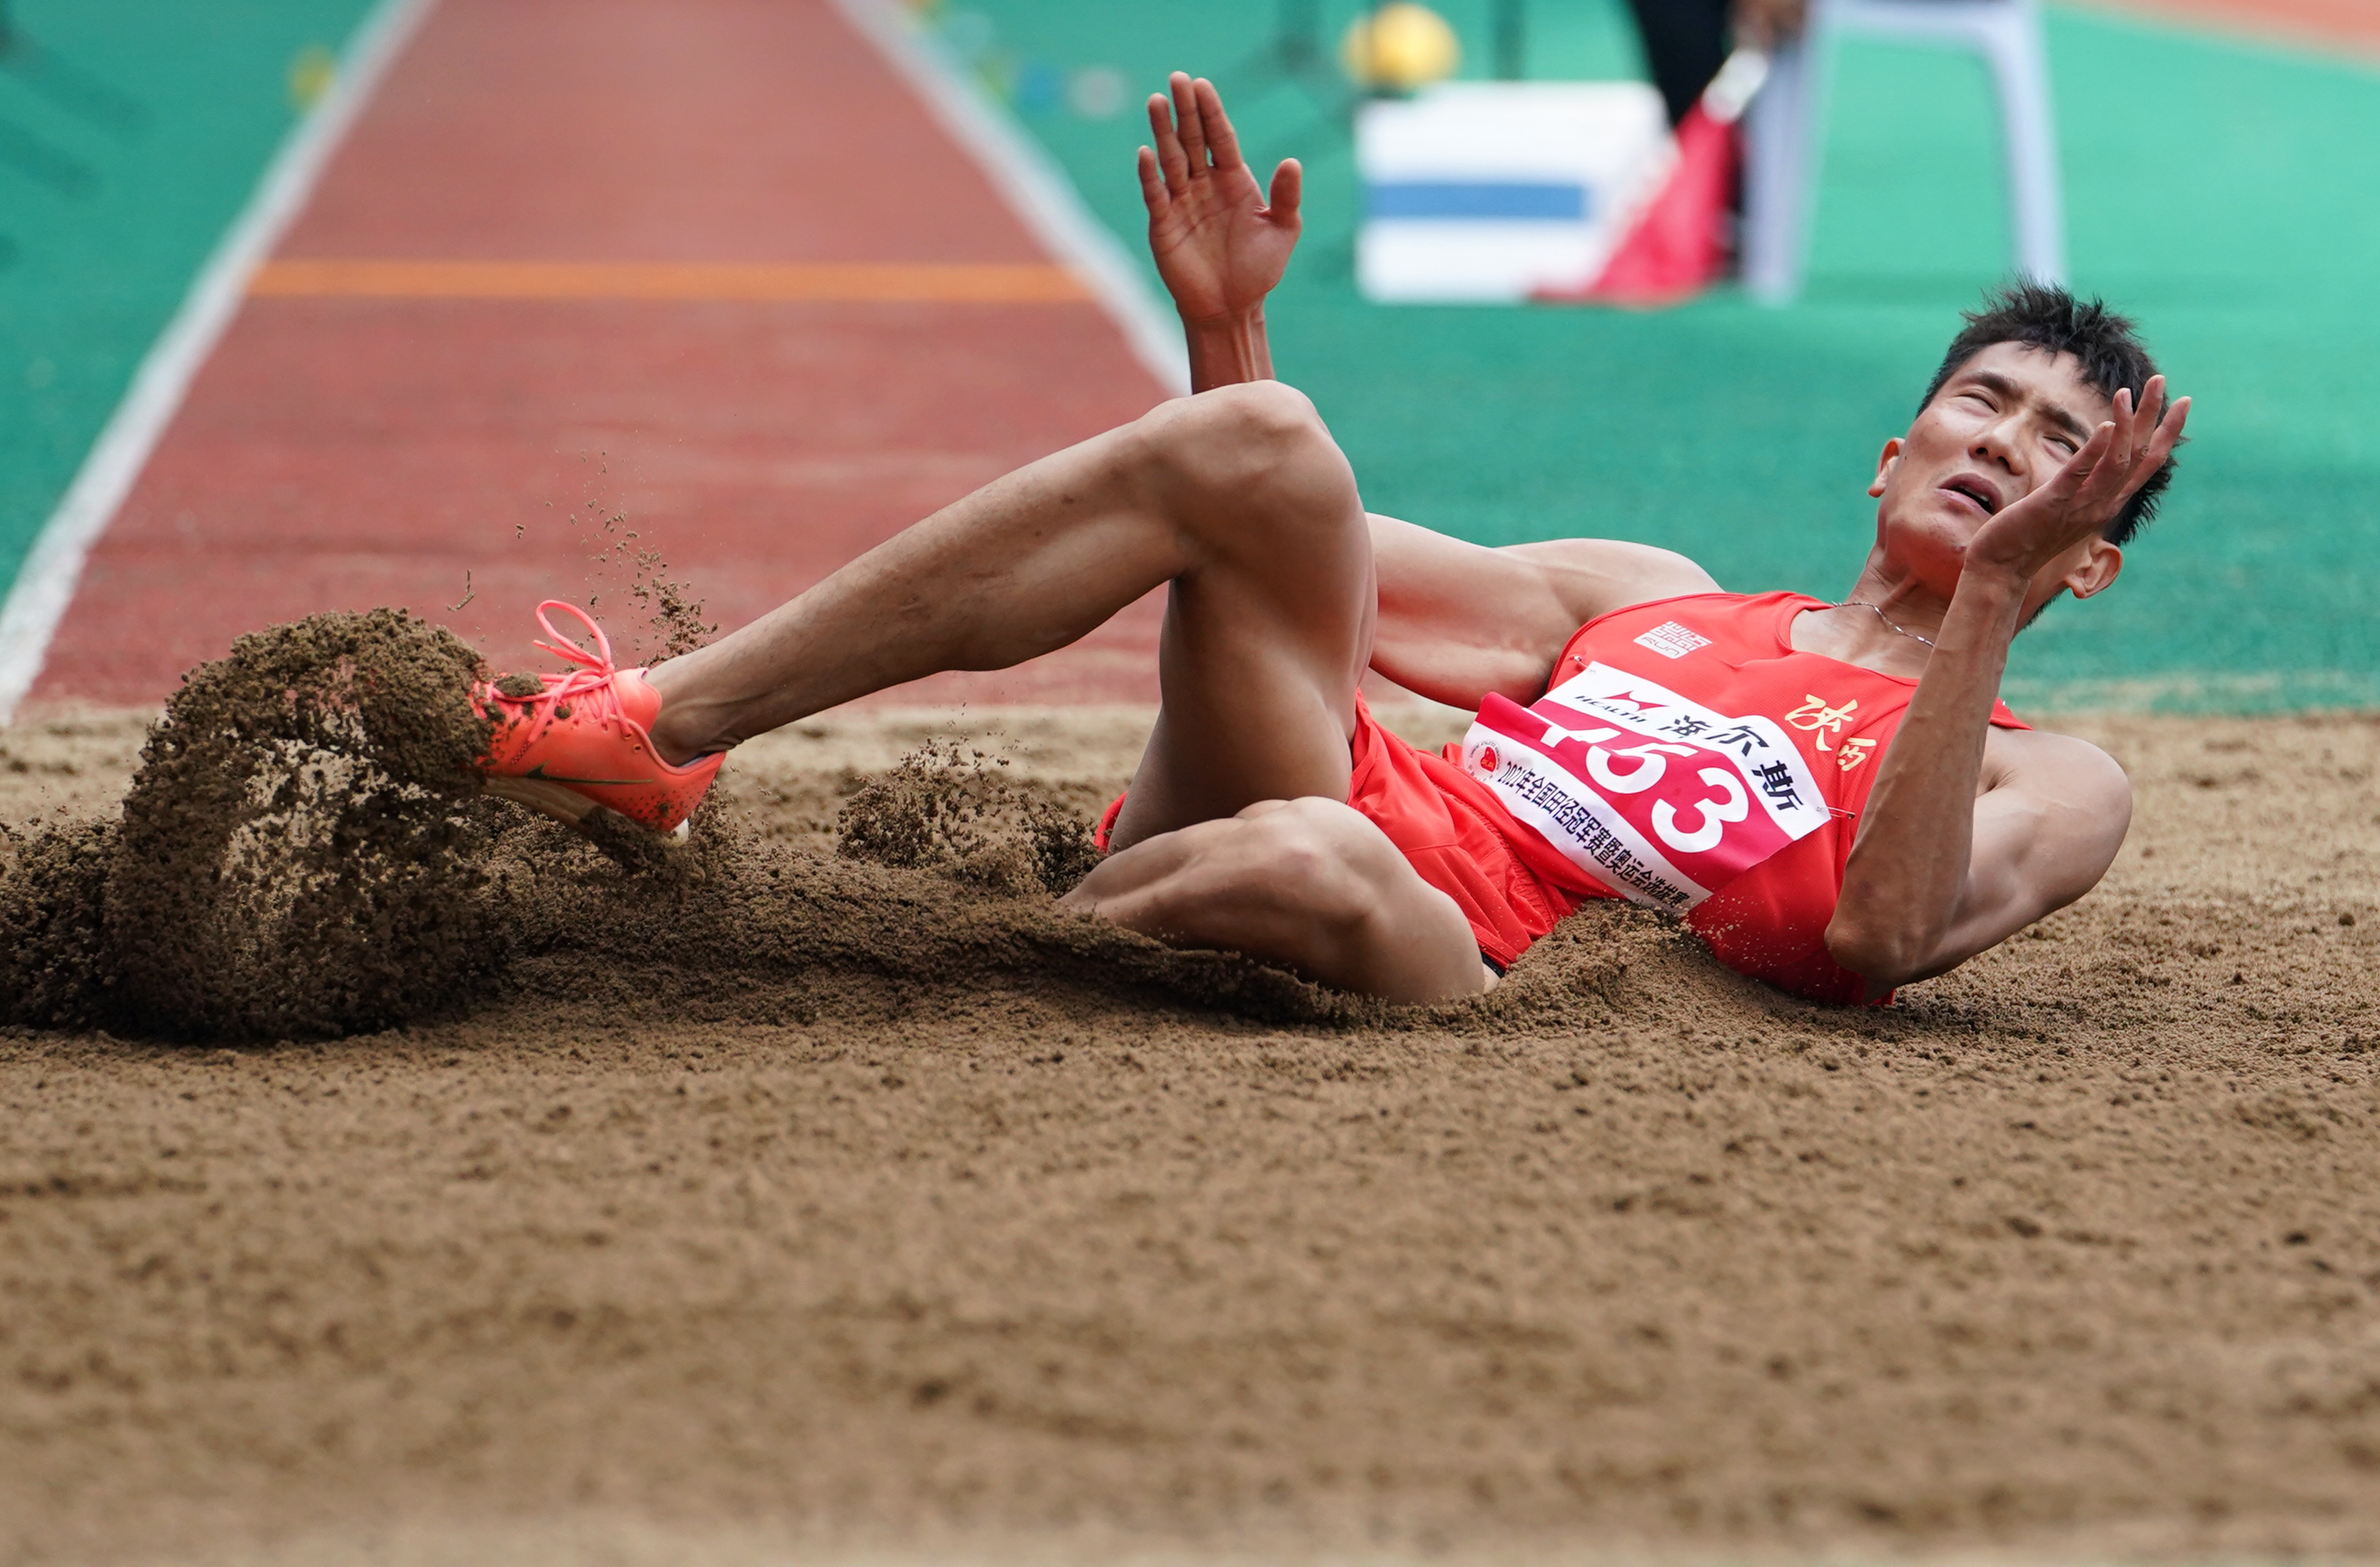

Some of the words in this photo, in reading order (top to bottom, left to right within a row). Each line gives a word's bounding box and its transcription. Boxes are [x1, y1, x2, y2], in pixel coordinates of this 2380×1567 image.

[1574, 695, 1647, 723] HEALTH
[1656, 714, 1803, 811] 海尔斯
